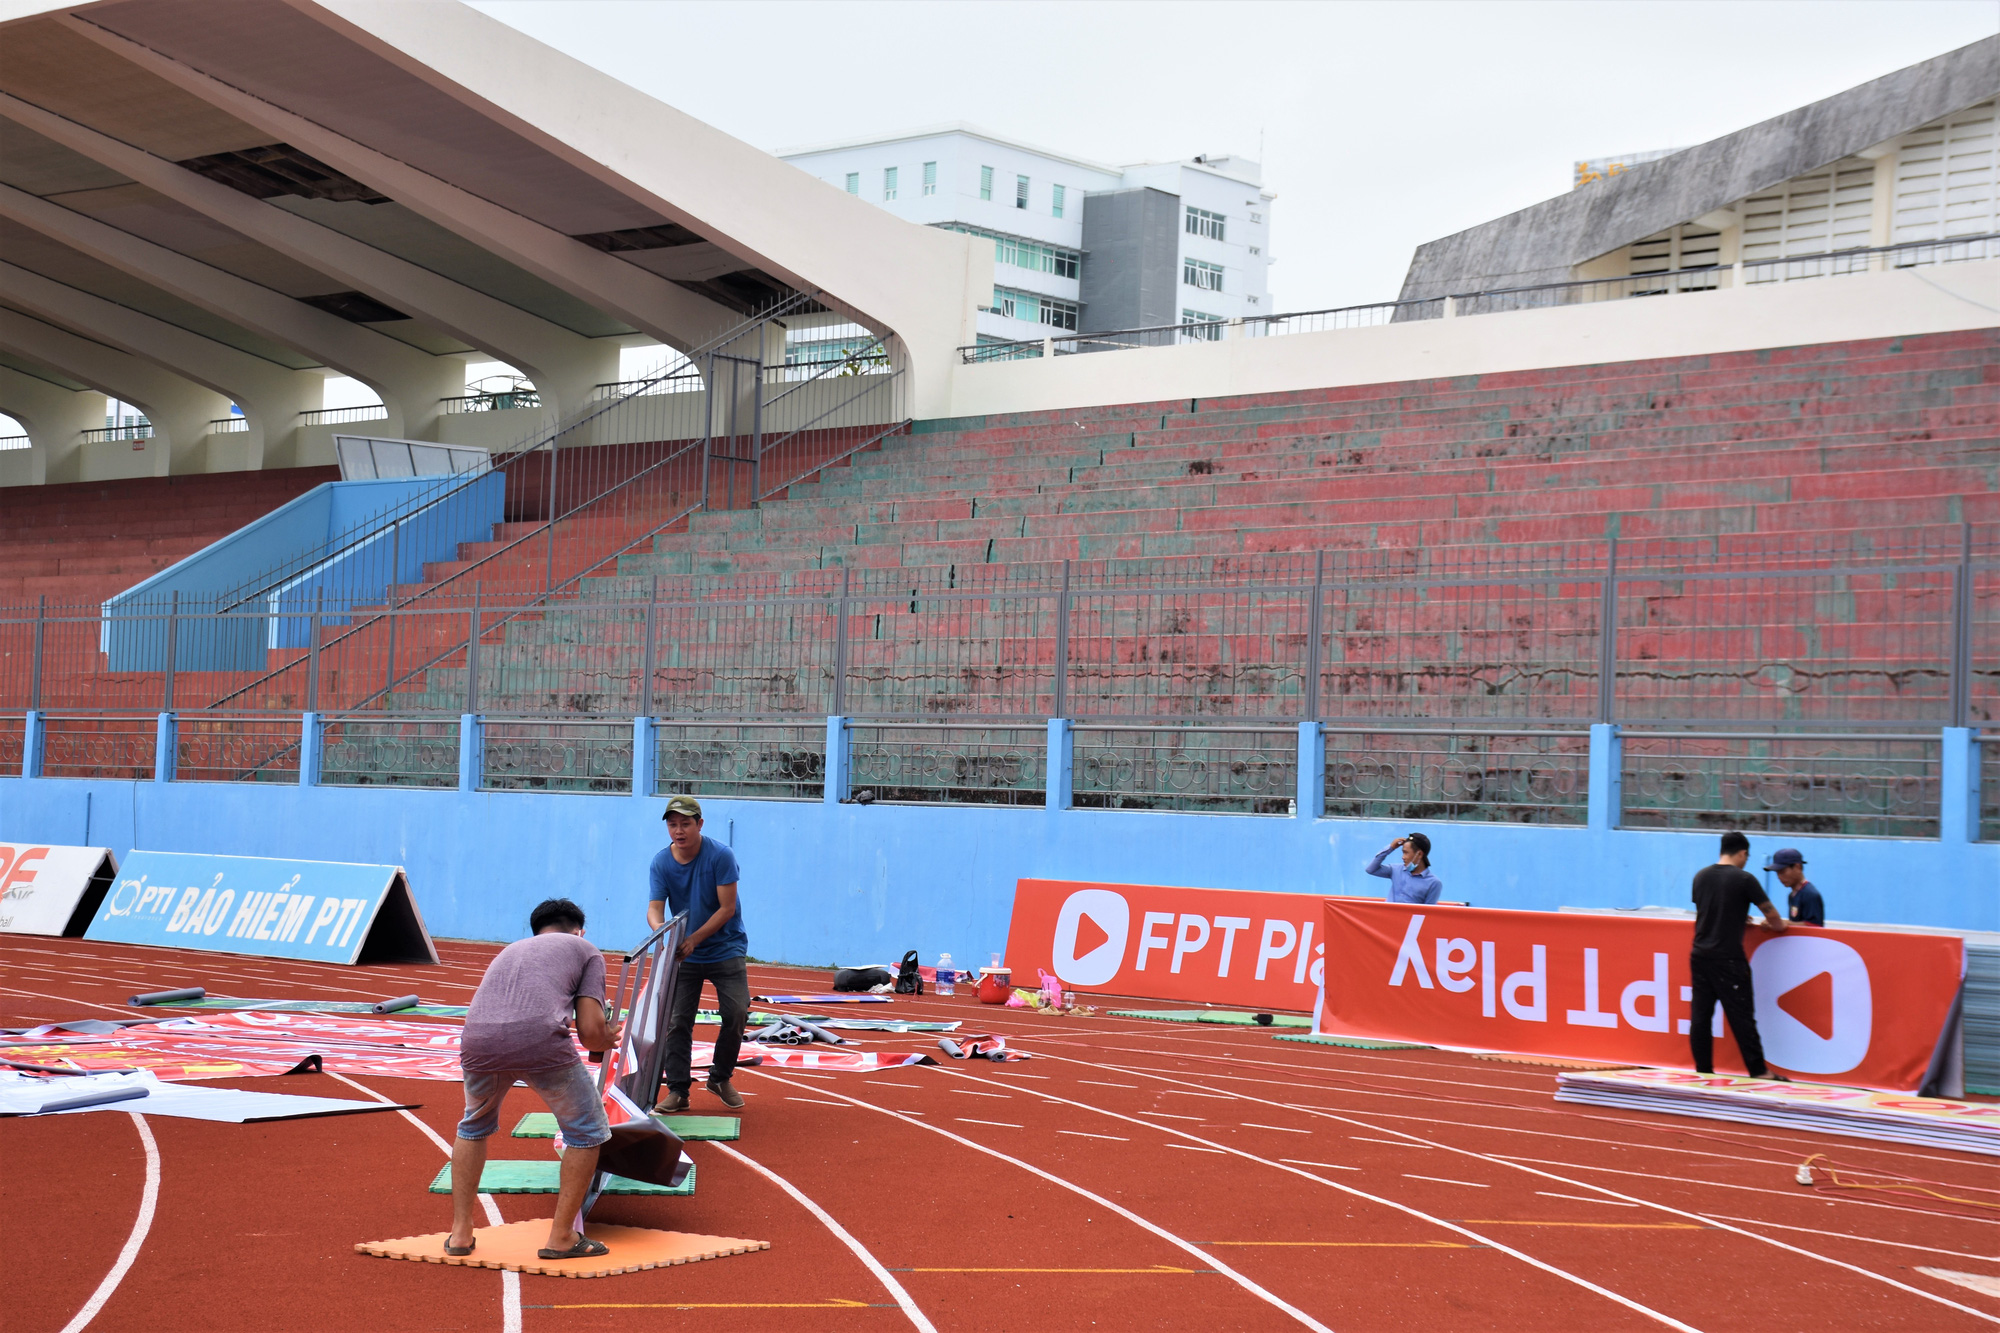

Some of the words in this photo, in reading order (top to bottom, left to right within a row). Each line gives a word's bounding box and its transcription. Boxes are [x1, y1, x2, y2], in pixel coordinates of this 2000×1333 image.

[135, 886, 178, 915] PTI
[165, 872, 236, 937] BẢO
[226, 873, 316, 943] HIỂM
[304, 897, 368, 948] PTI
[1135, 911, 1251, 978] FPT
[1388, 914, 1548, 1022] Play
